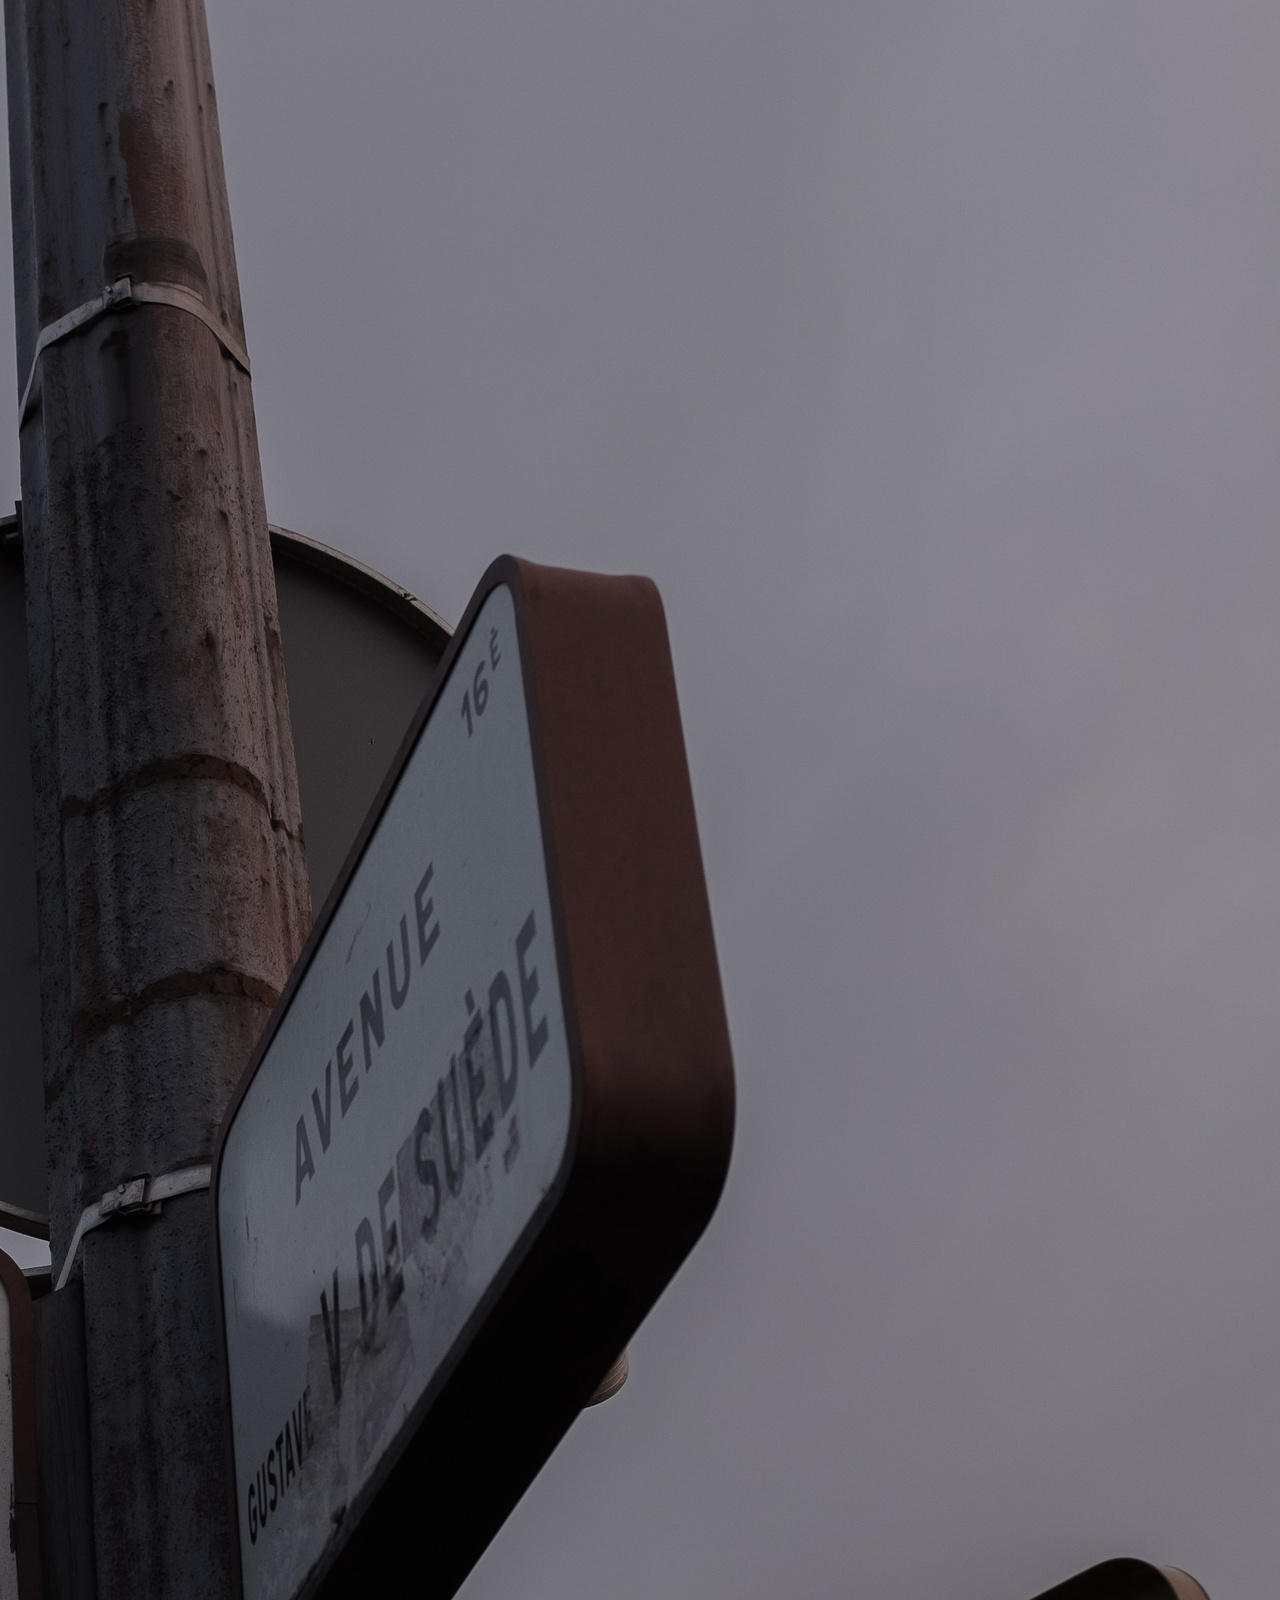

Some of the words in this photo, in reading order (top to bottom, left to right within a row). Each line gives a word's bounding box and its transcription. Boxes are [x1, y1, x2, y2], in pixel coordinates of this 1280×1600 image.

[247, 1384, 315, 1546] GUSTAVE
[320, 1266, 342, 1406] V
[354, 1166, 405, 1350] DE
[415, 909, 549, 1245] SUÈDE
[294, 861, 441, 1207] AVENUE
